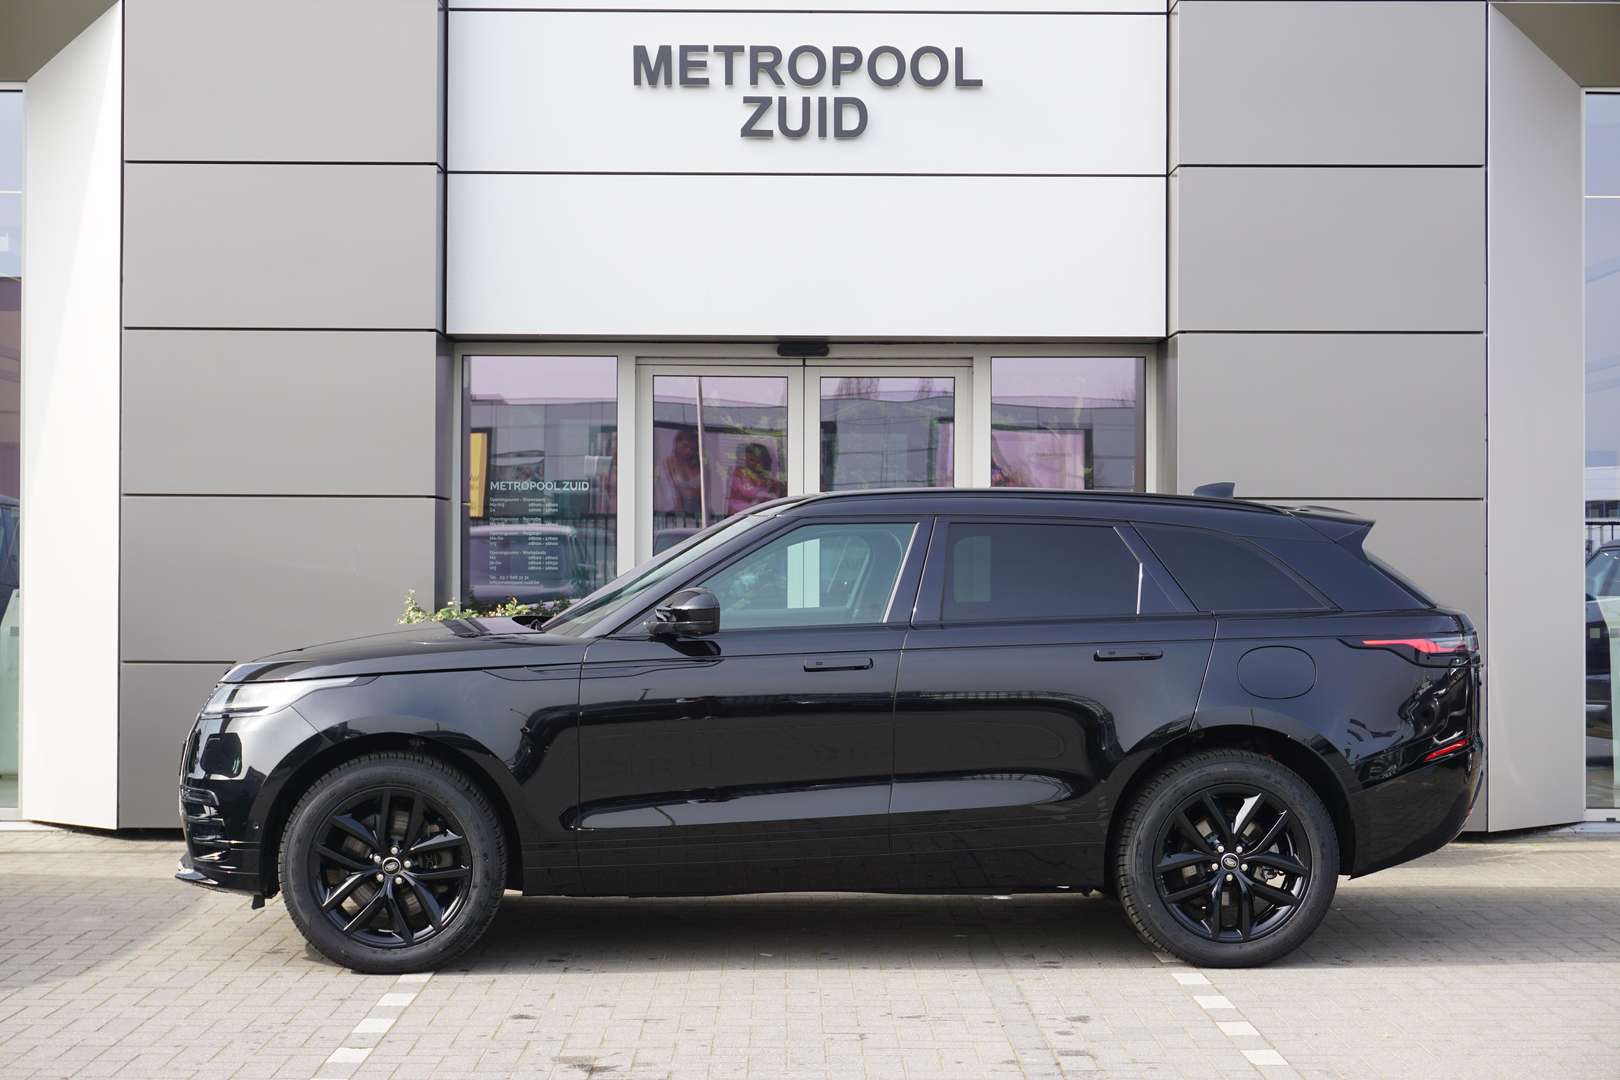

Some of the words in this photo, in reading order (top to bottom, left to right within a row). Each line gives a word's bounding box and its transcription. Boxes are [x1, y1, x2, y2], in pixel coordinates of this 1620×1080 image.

[633, 45, 984, 88] METROPOOL
[740, 96, 869, 139] ZUID
[489, 481, 560, 491] METROPOOL
[562, 481, 590, 491] ZUID
